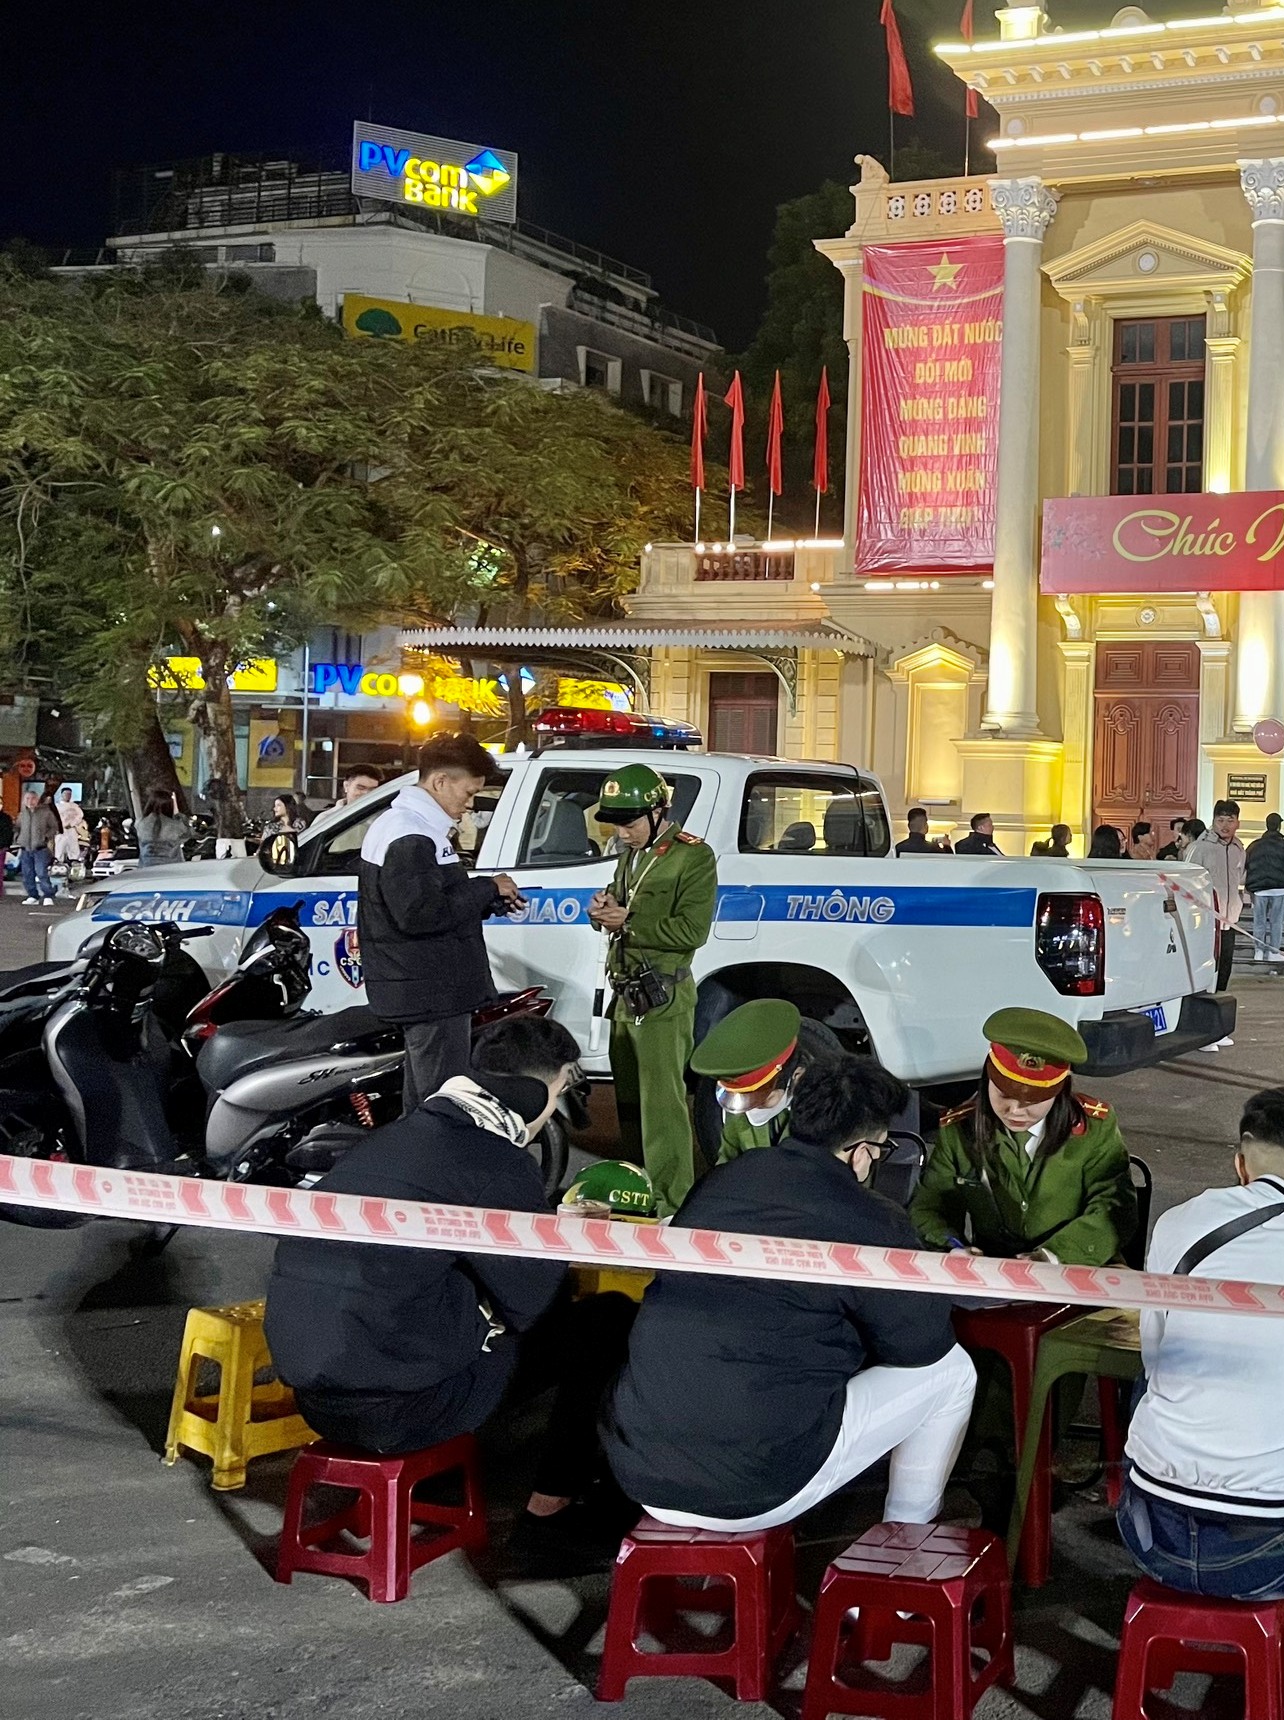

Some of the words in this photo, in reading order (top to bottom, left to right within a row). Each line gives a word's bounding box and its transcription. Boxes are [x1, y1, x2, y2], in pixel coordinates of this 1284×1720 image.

[403, 176, 479, 214] Bank
[1112, 509, 1237, 562] Chúc
[120, 893, 196, 922] CẢNH
[312, 891, 359, 926] SÁT
[508, 895, 582, 924] GIAO
[785, 888, 896, 923] THÔNG
[608, 1189, 650, 1207] CSTT
